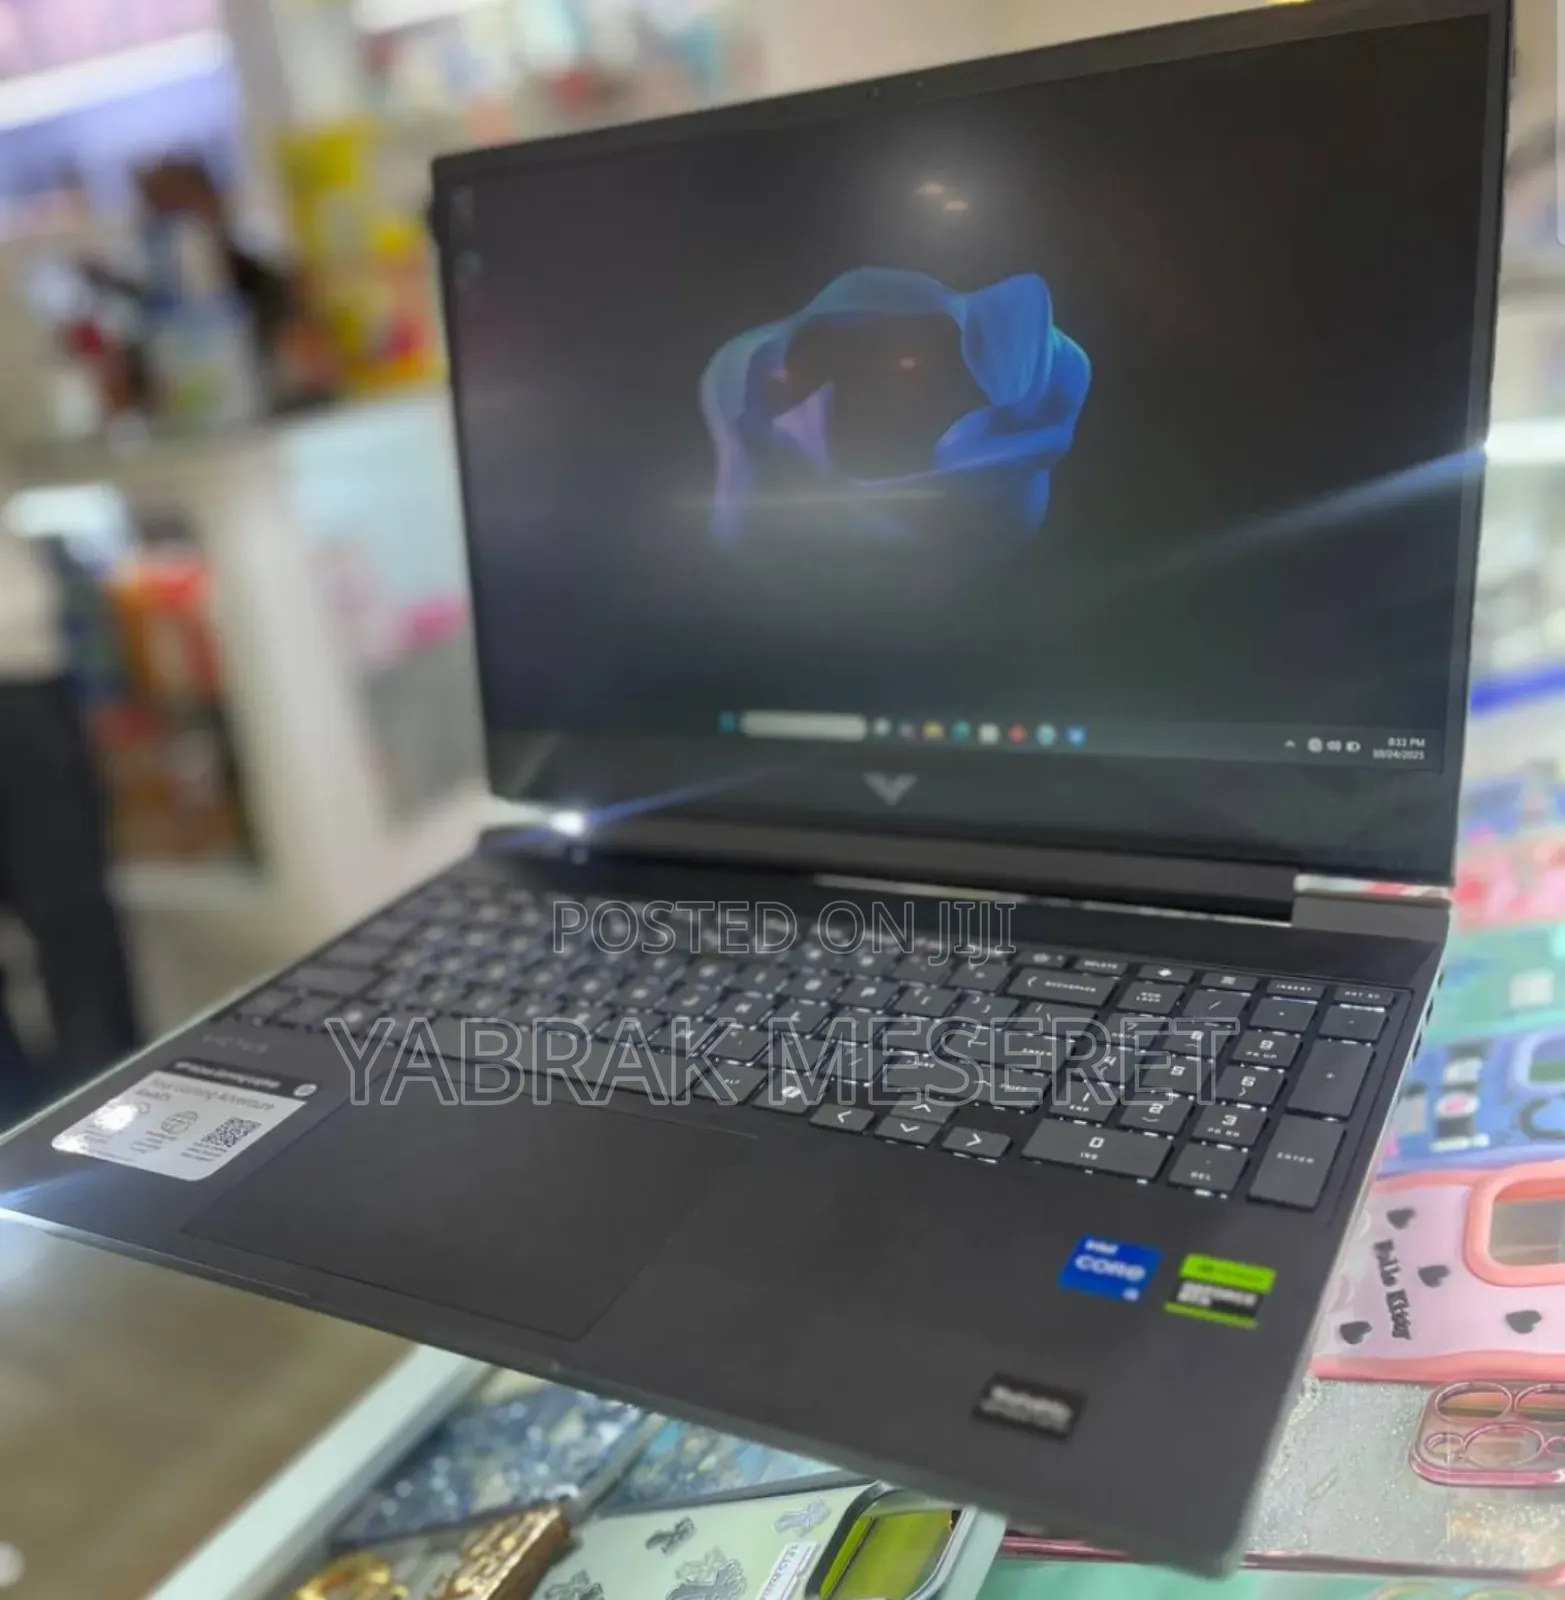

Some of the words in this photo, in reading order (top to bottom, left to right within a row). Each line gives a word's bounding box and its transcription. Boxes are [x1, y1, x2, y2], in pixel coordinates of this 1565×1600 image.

[1409, 738, 1425, 748] PM
[1276, 983, 1313, 992] INSERT
[1148, 1103, 1165, 1115] 2
[1221, 1114, 1238, 1127] 3
[1276, 1151, 1315, 1165] ENTER
